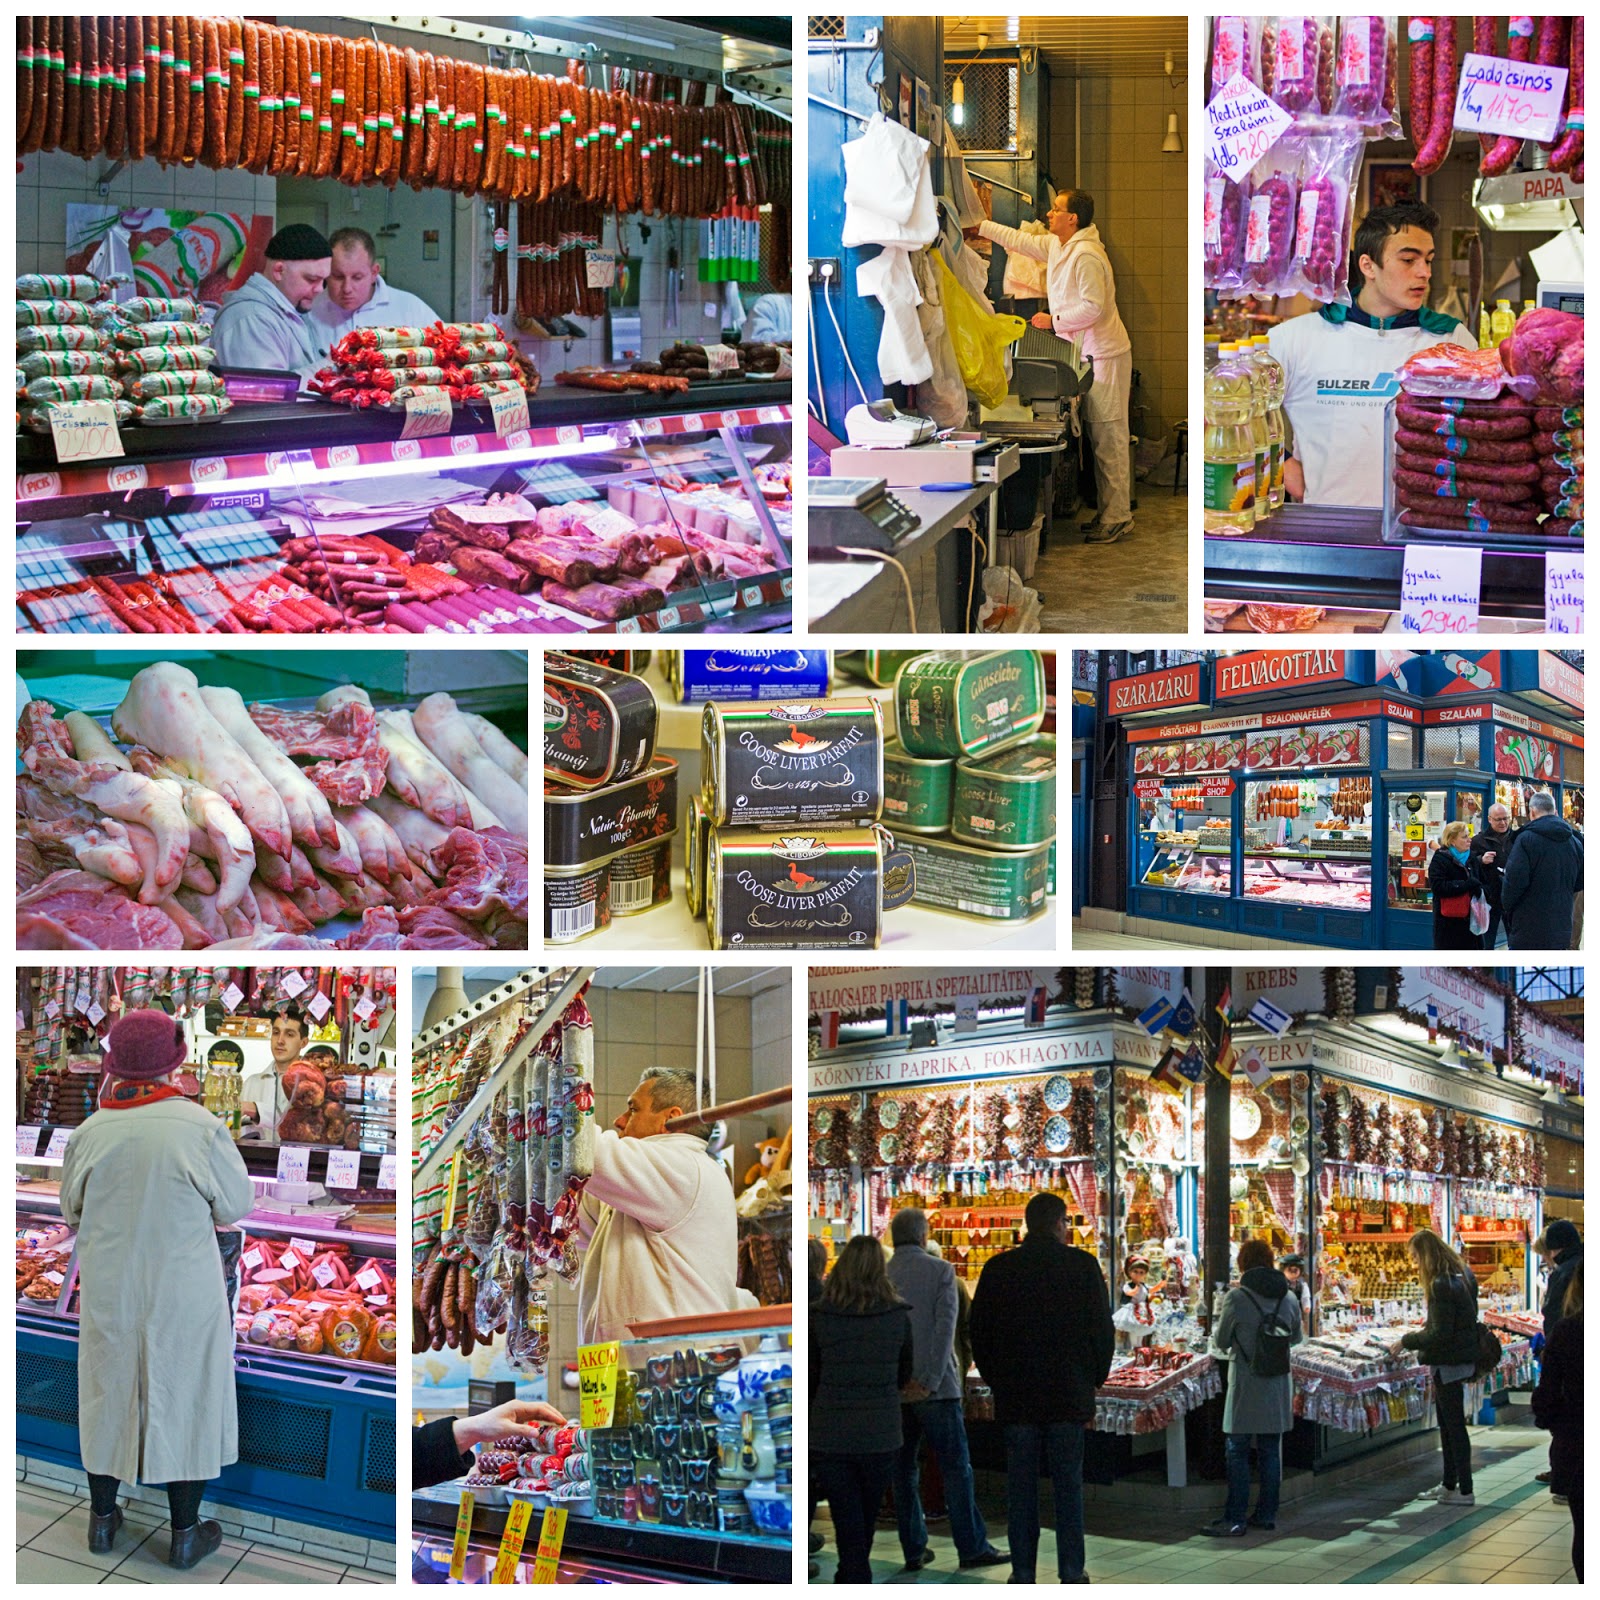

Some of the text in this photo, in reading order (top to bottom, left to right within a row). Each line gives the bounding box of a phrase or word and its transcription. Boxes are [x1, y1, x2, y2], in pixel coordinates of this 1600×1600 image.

[1523, 177, 1566, 200] PAPA
[1317, 379, 1370, 390] SULZER
[58, 426, 117, 458] 2200
[115, 469, 138, 486] PICK
[198, 463, 217, 478] PICK
[26, 476, 51, 494] PICK
[1404, 568, 1442, 585] Gyulai
[1221, 650, 1338, 692] FELVÁGOTTAK
[1115, 672, 1194, 709] SZÁRAZÁRU
[1245, 717, 1260, 726] KFT.
[1265, 706, 1332, 725] SZALONNAFÉLÉK
[1439, 706, 1483, 721] SZALÁMI
[739, 725, 864, 771] GOOSE LIVER PARFAIT
[1202, 777, 1230, 787] SALAMI
[1206, 787, 1227, 796] SHOP
[1139, 789, 1157, 798] SHOP
[736, 866, 864, 910] GOOSE LIVER PARFAIT
[1246, 967, 1298, 992] KREBS
[809, 984, 877, 1010] KALOCSAER
[880, 979, 933, 1003] PAPRIKA
[1113, 1039, 1162, 1061] SAVANY
[813, 1060, 892, 1087] KÖRNYÉKI
[984, 1039, 1105, 1069] FOKHAGYMA
